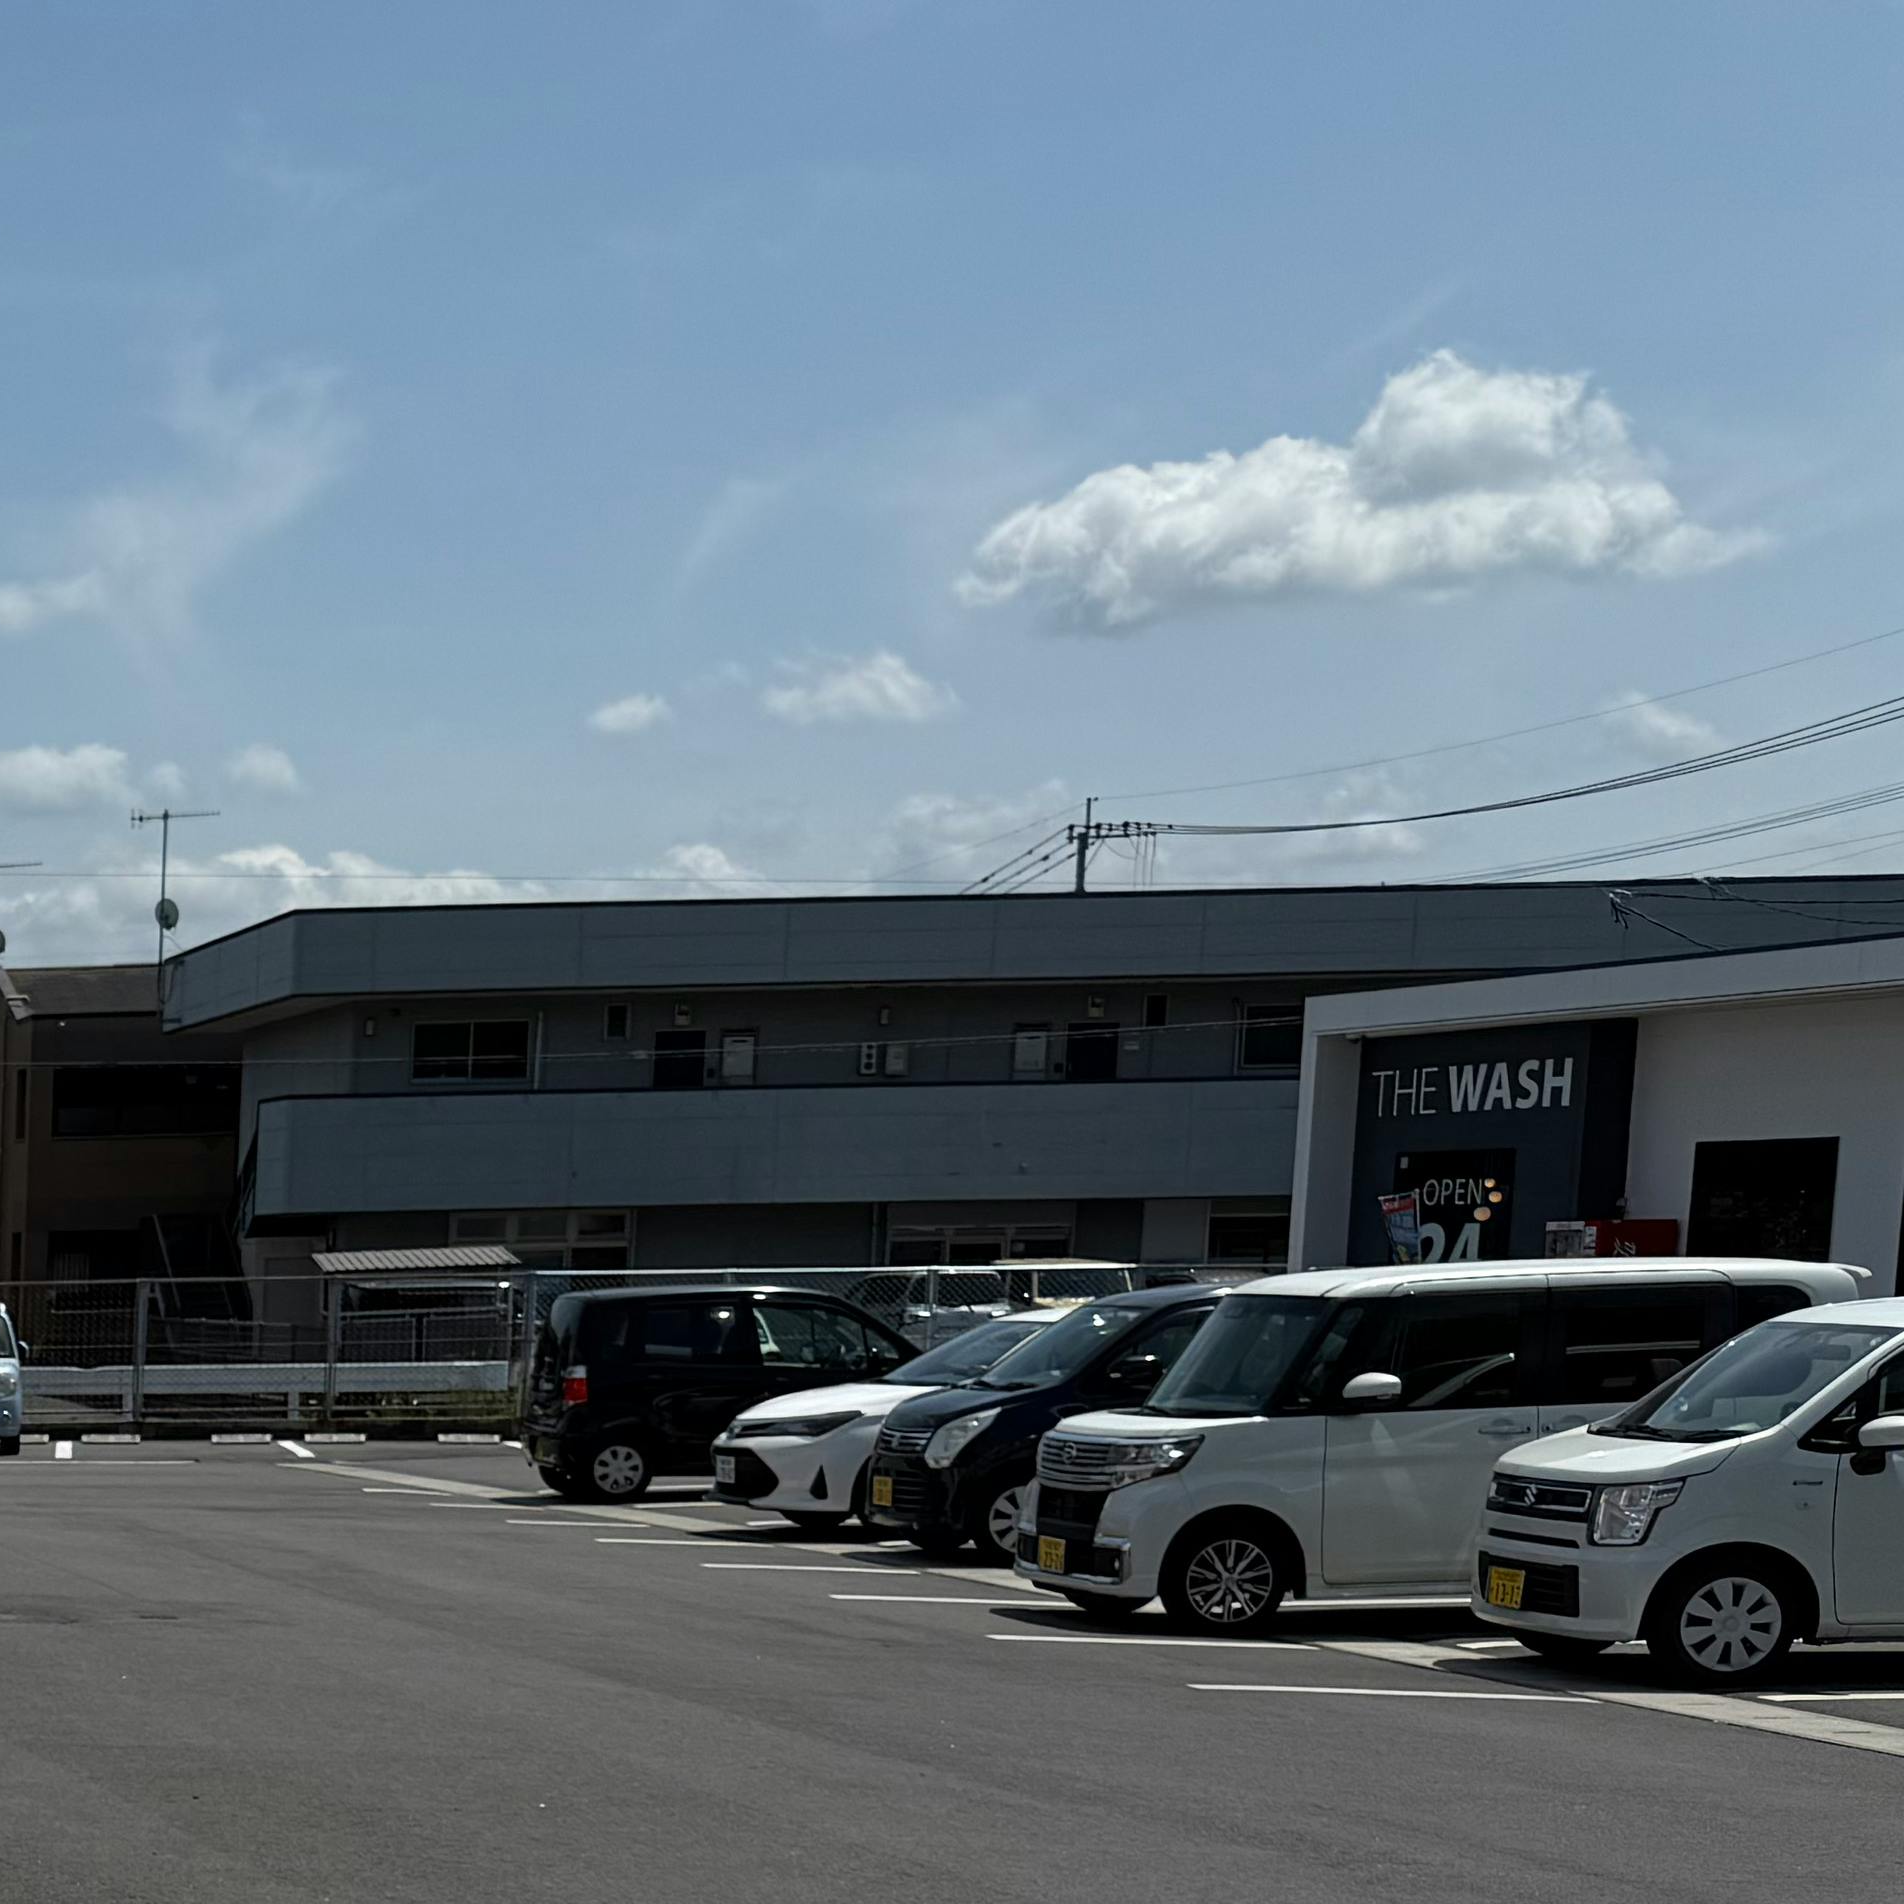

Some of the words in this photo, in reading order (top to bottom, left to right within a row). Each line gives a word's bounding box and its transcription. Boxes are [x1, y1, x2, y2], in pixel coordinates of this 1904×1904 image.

[1372, 1067, 1440, 1118] THE
[1449, 1057, 1574, 1114] WASH
[1423, 1178, 1483, 1206] OPEN
